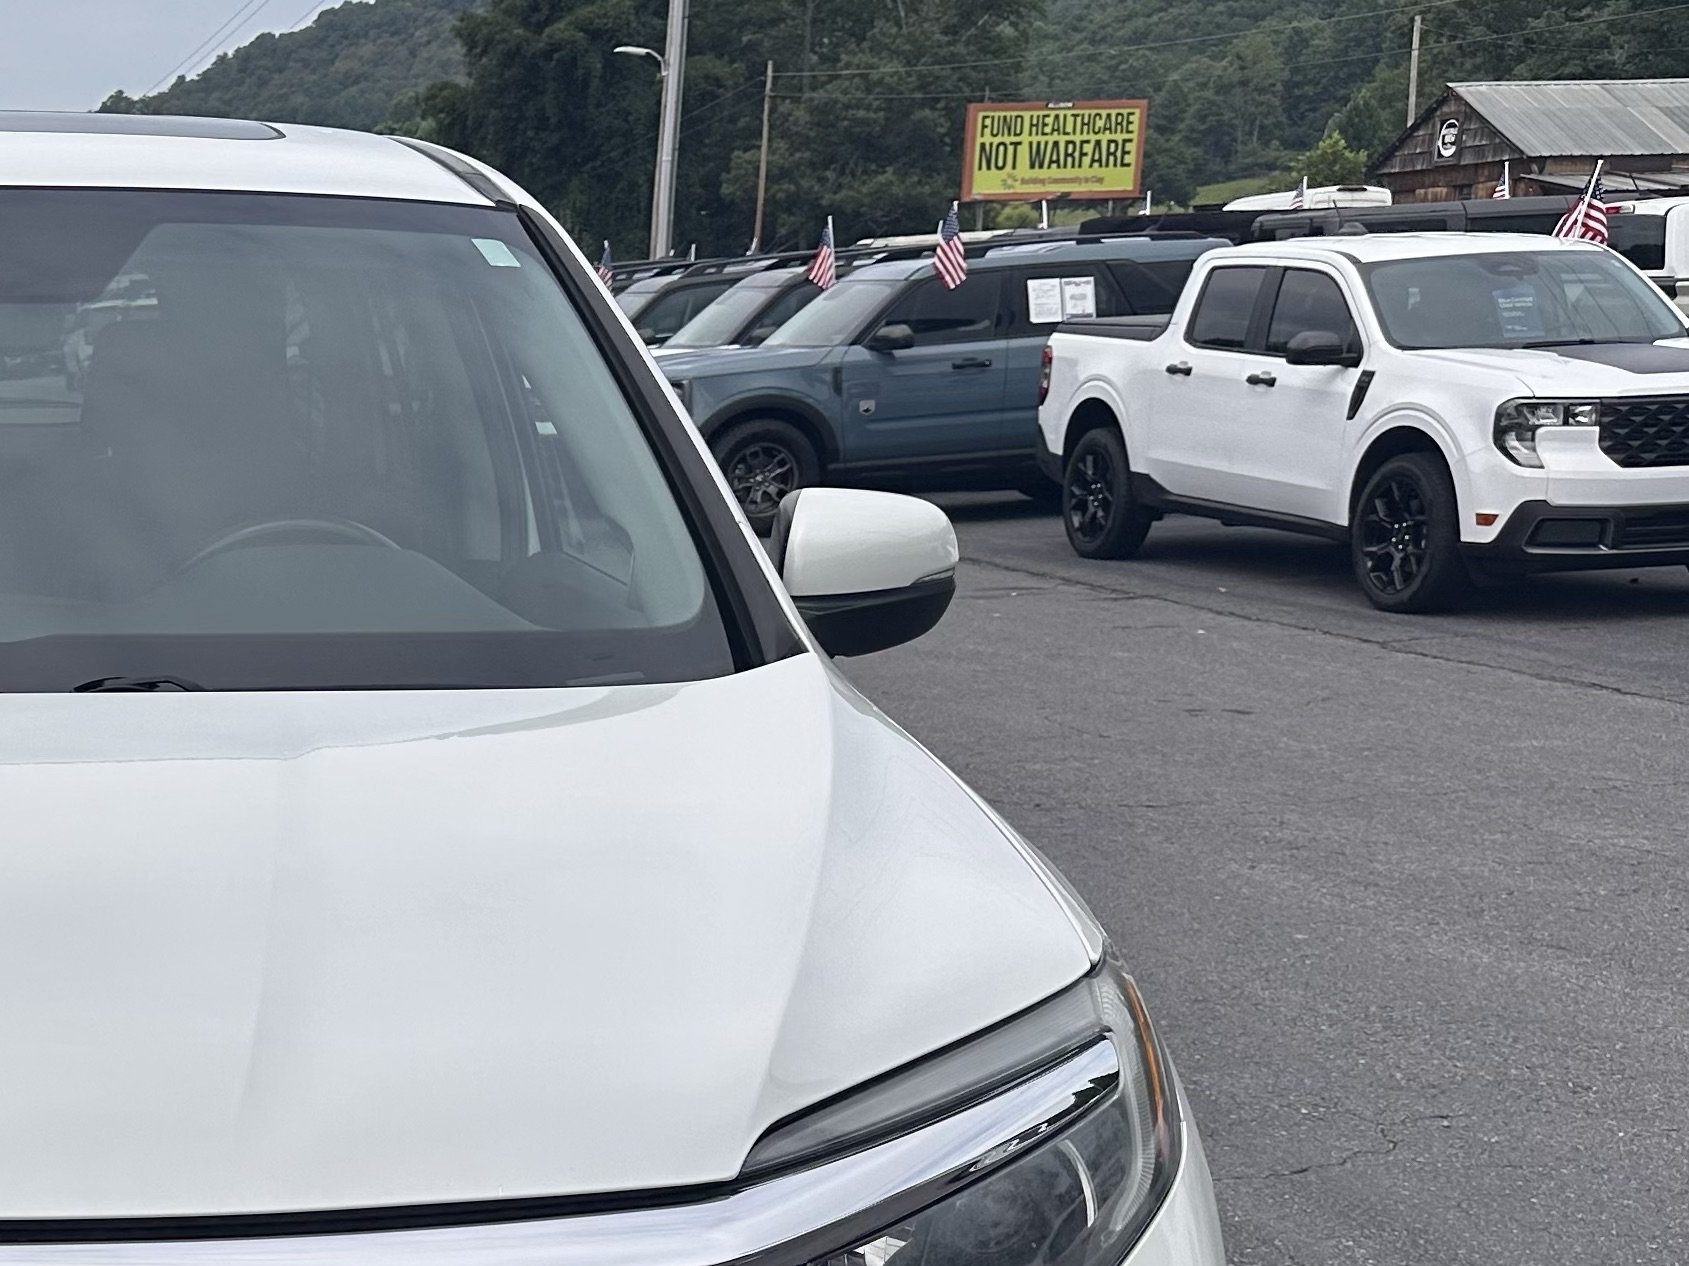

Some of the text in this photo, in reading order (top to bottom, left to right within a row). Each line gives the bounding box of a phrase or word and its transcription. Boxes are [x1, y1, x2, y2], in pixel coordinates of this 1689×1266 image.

[980, 112, 1136, 138] FUND HEALTHCARE
[977, 138, 1134, 172] NOT WARFARE
